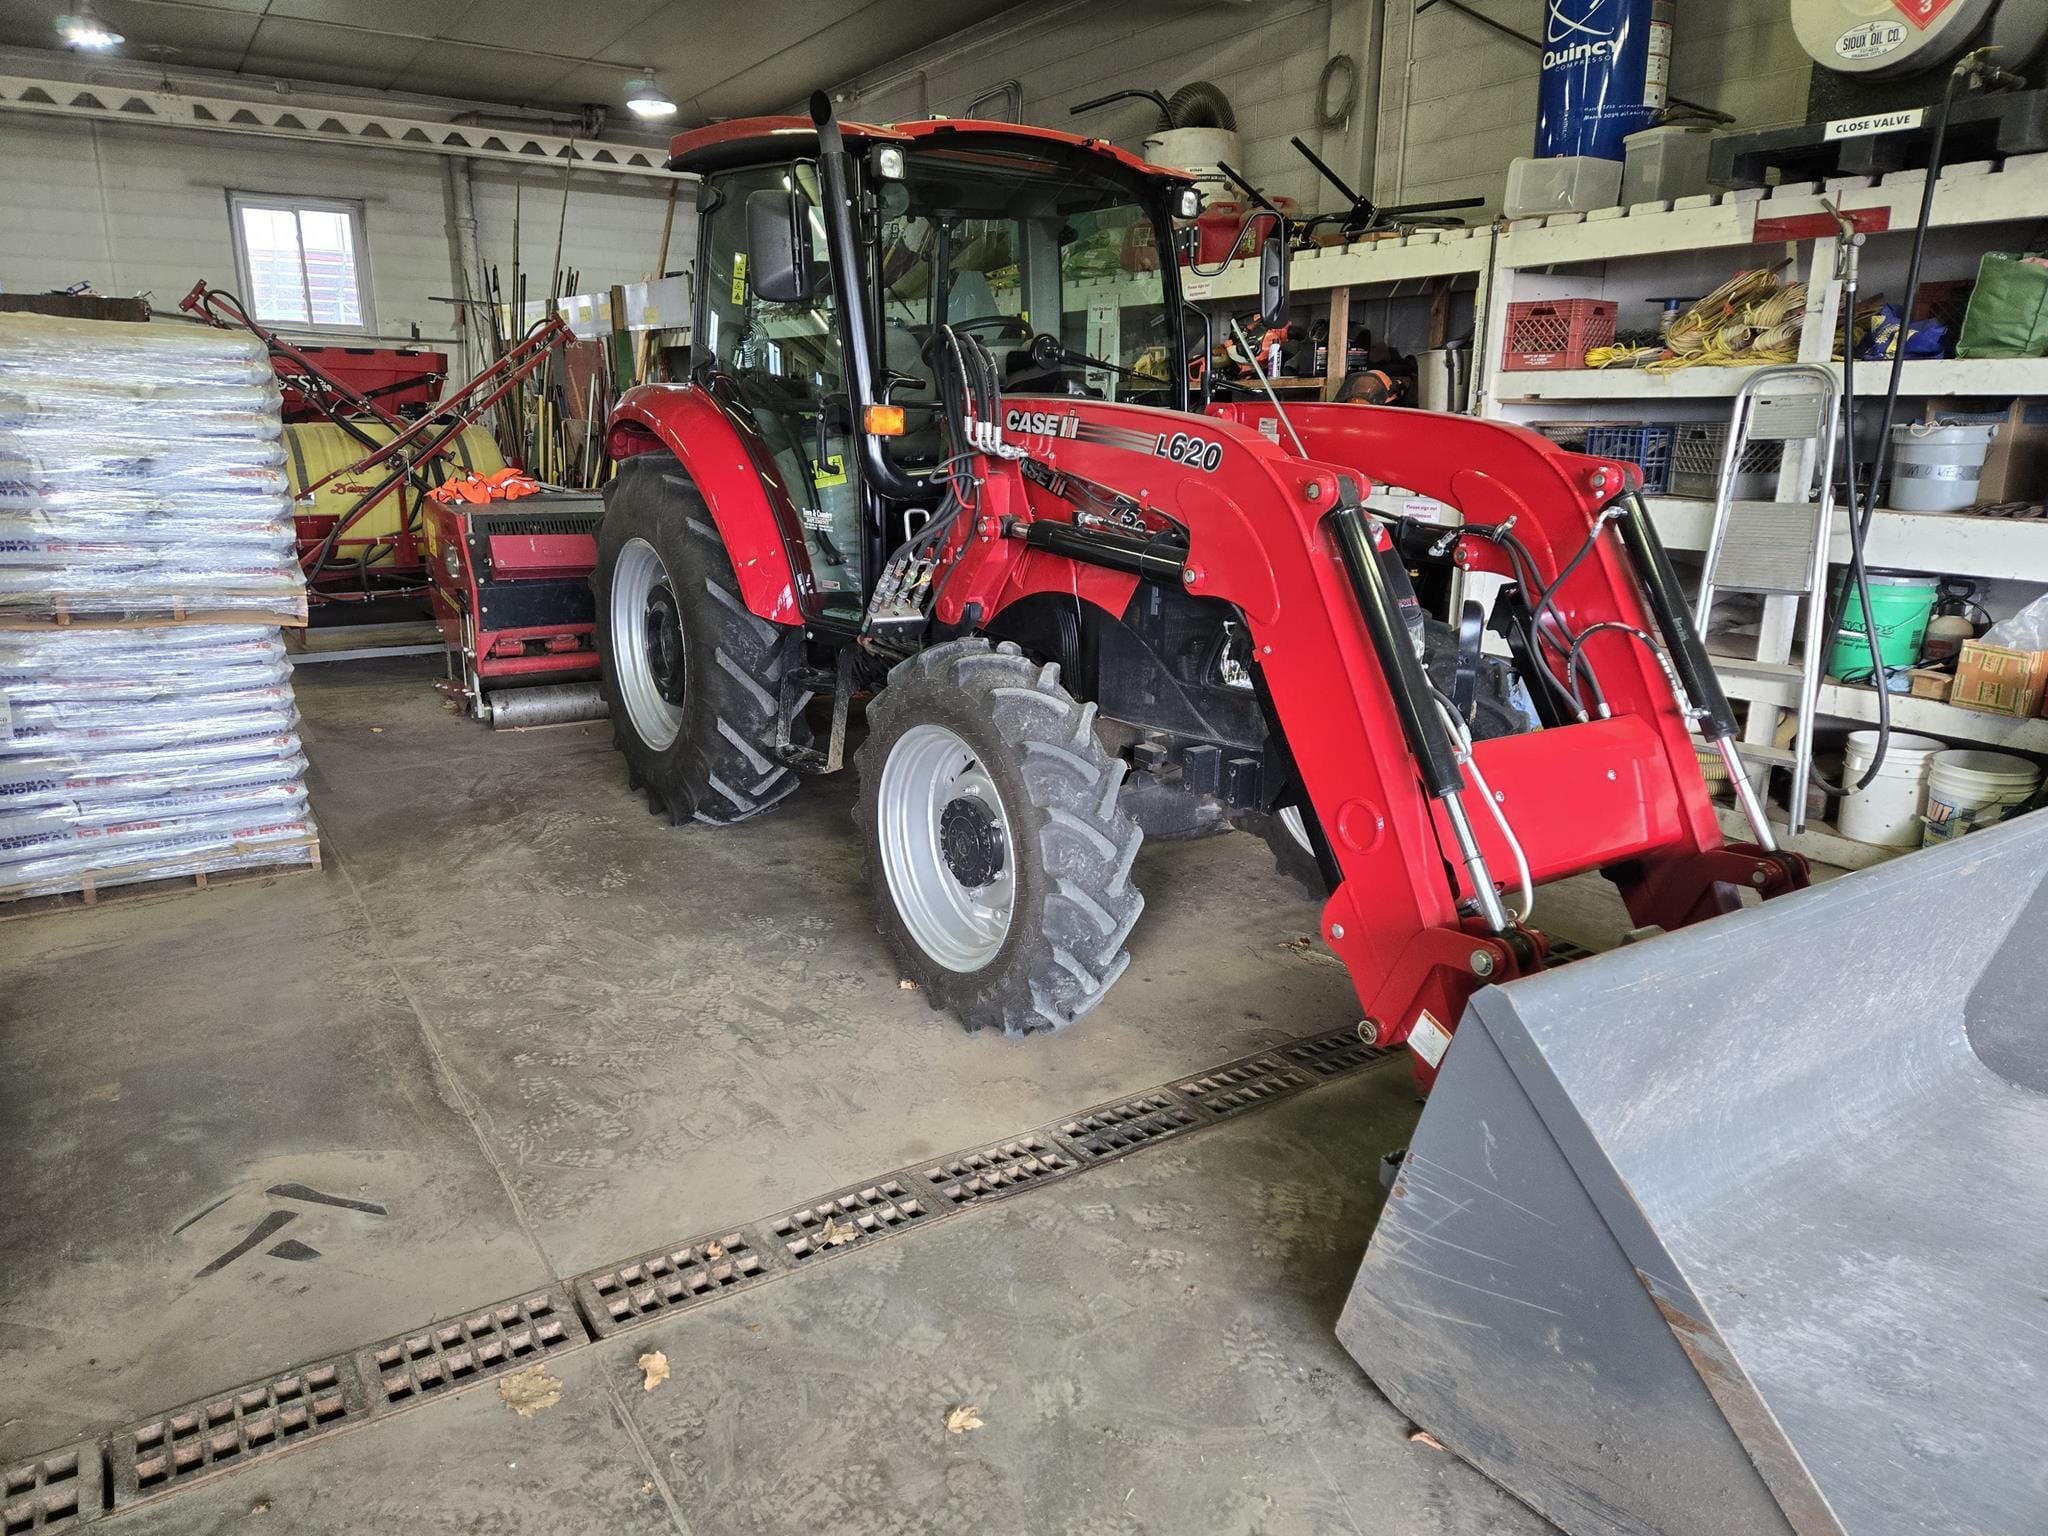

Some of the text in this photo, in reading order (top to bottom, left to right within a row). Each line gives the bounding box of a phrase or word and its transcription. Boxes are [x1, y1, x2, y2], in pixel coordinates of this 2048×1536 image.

[1842, 34, 1867, 51] SIOUX
[1870, 32, 1883, 46] OIL
[1887, 28, 1901, 42] CO.
[1836, 114, 1911, 134] CLOSE VALVE
[1006, 410, 1059, 437] CASE
[1154, 432, 1223, 473] L620
